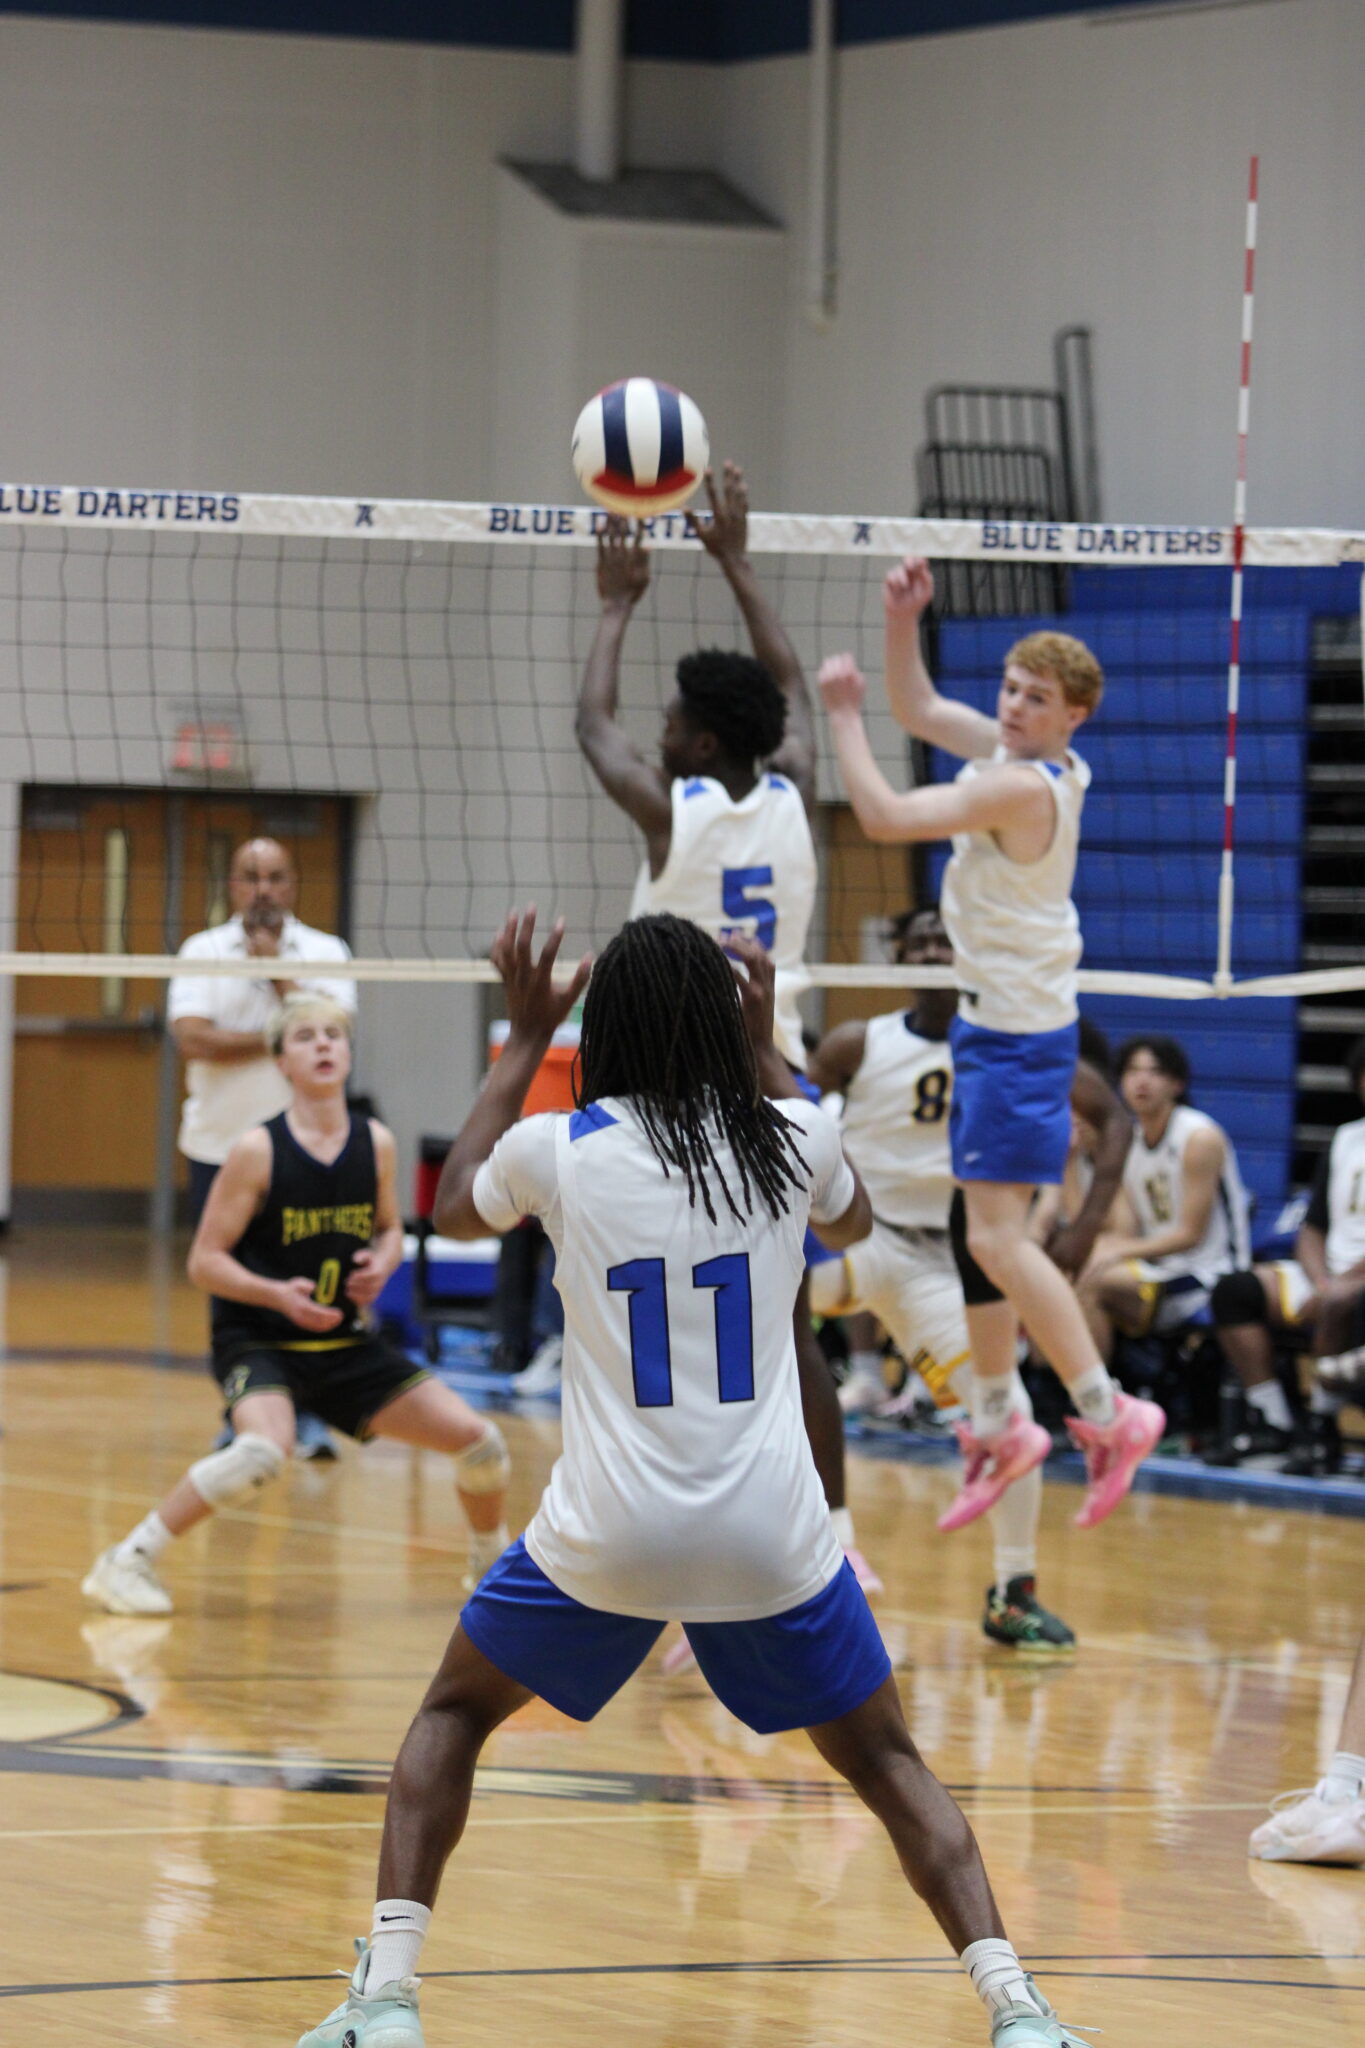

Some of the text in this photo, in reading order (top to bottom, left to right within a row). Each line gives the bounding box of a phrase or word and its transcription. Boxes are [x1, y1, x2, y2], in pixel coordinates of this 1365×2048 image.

[77, 491, 240, 523] DARTERS
[489, 507, 576, 535] BLUE
[981, 523, 1223, 556] BLUE DARTERS
[720, 865, 777, 963] 5
[911, 1068, 949, 1124] 8
[282, 1204, 373, 1245] PANTHERS
[316, 1258, 341, 1305] 0
[607, 1252, 756, 1409] 11
